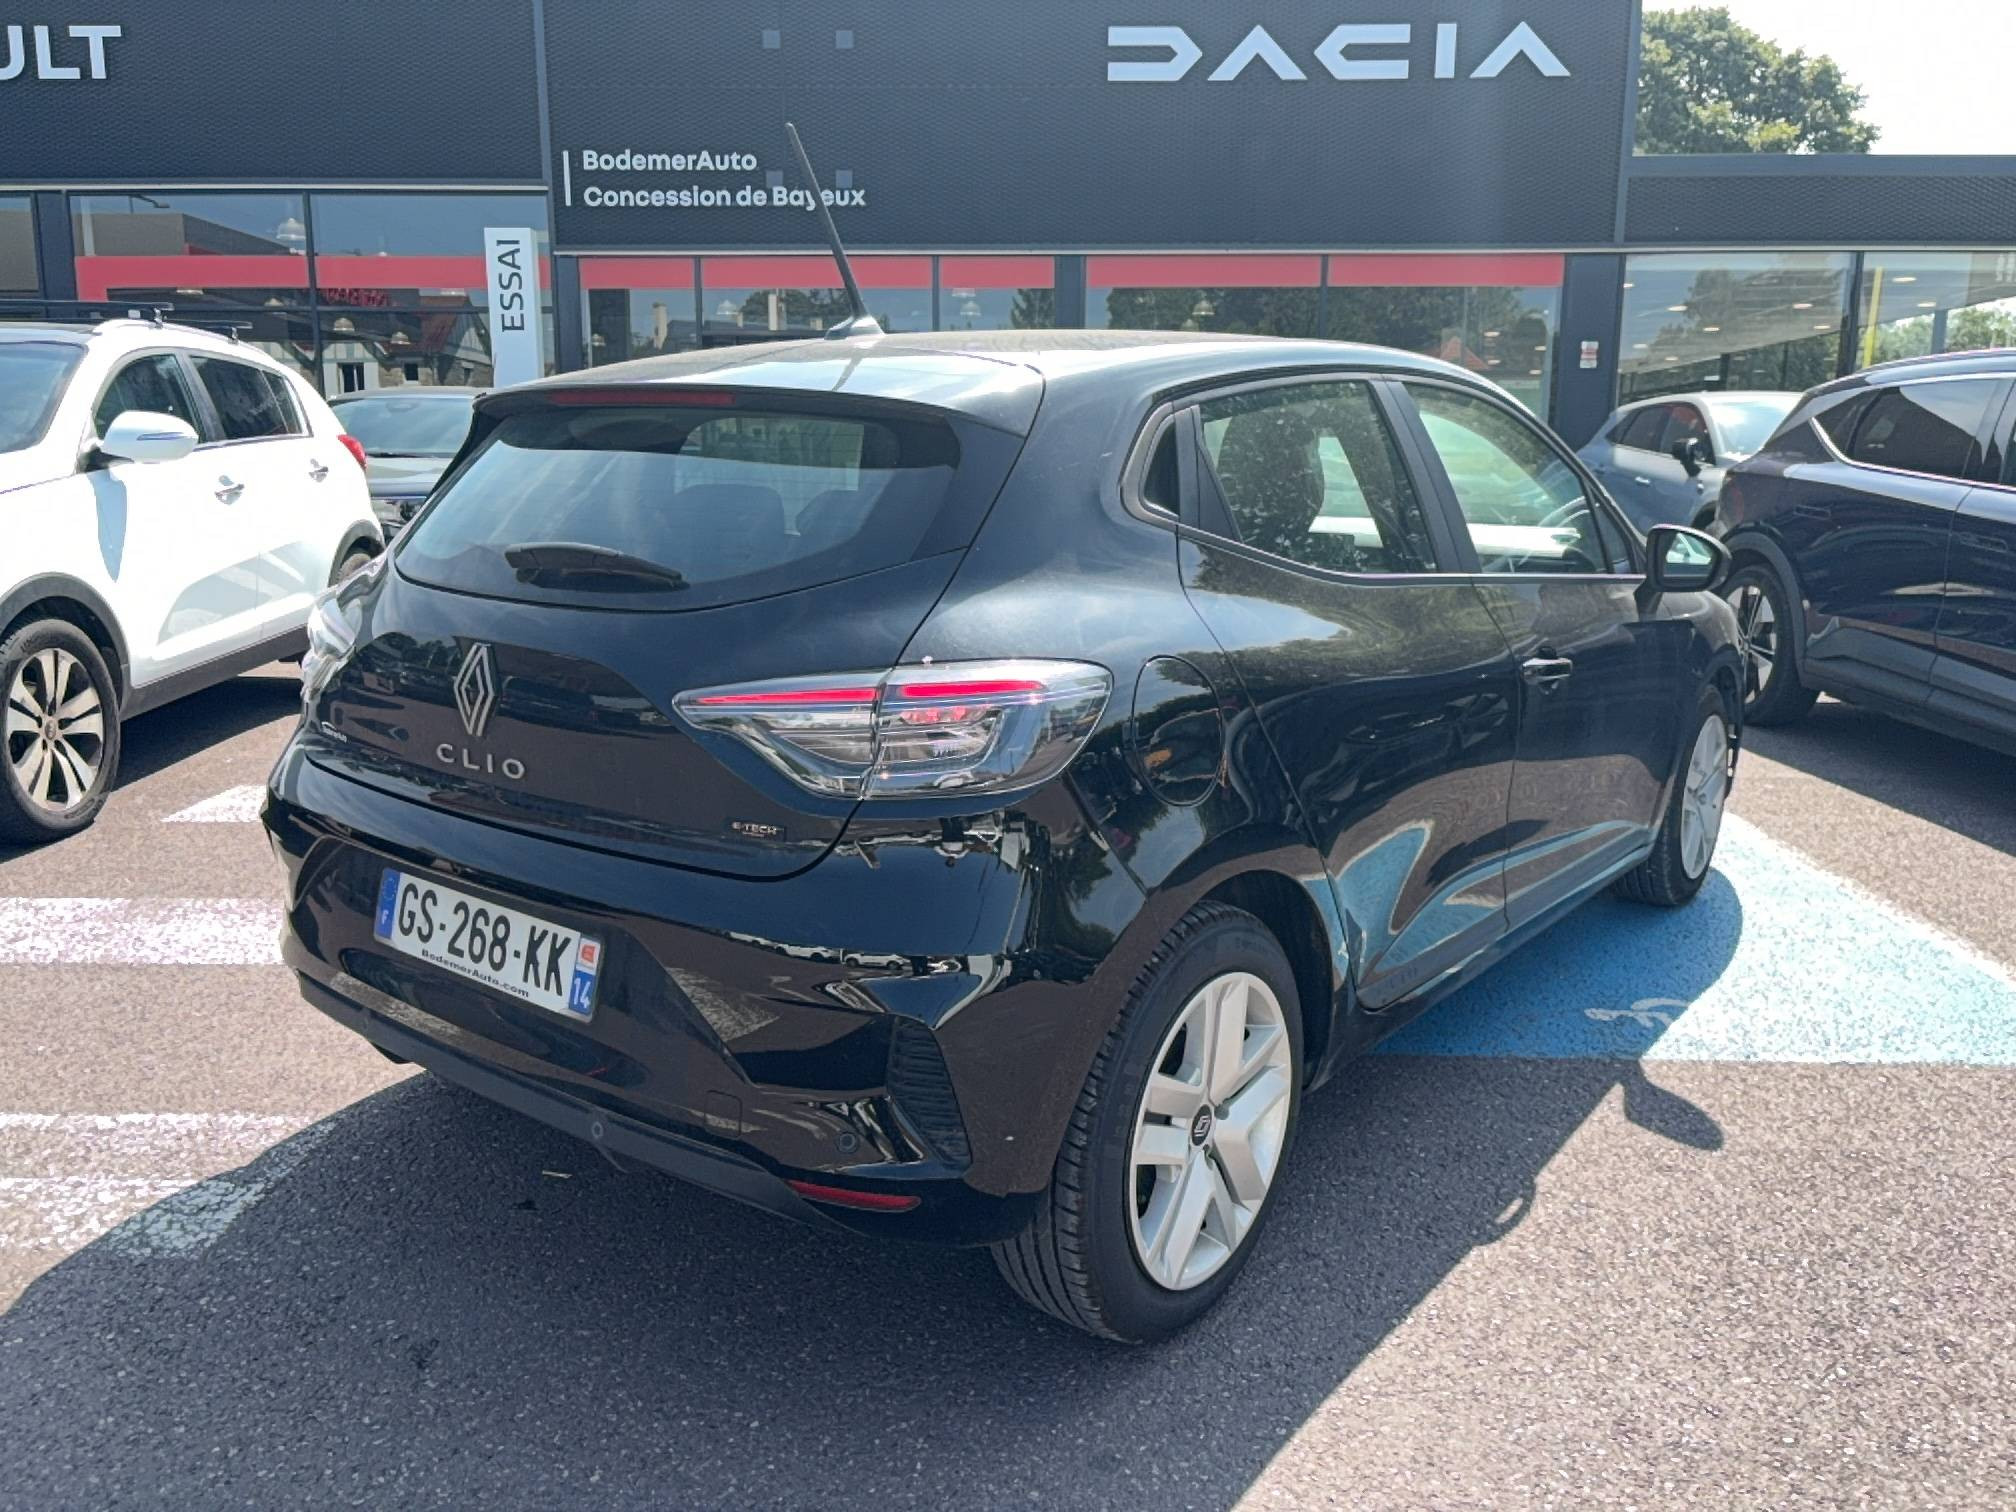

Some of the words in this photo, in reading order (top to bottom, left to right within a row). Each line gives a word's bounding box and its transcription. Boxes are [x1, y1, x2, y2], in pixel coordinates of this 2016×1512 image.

[1107, 21, 1571, 81] DACIA
[582, 149, 757, 171] BodemerAuto
[583, 186, 731, 206] Concession
[736, 186, 767, 206] de
[773, 186, 866, 211] Bayeux
[496, 239, 525, 333] ESSAI
[436, 743, 525, 779] CLIO
[380, 909, 390, 926] F
[398, 882, 572, 997] GS-268-KK
[421, 947, 530, 998] BodemerAuto.com
[573, 976, 593, 1010] 14
